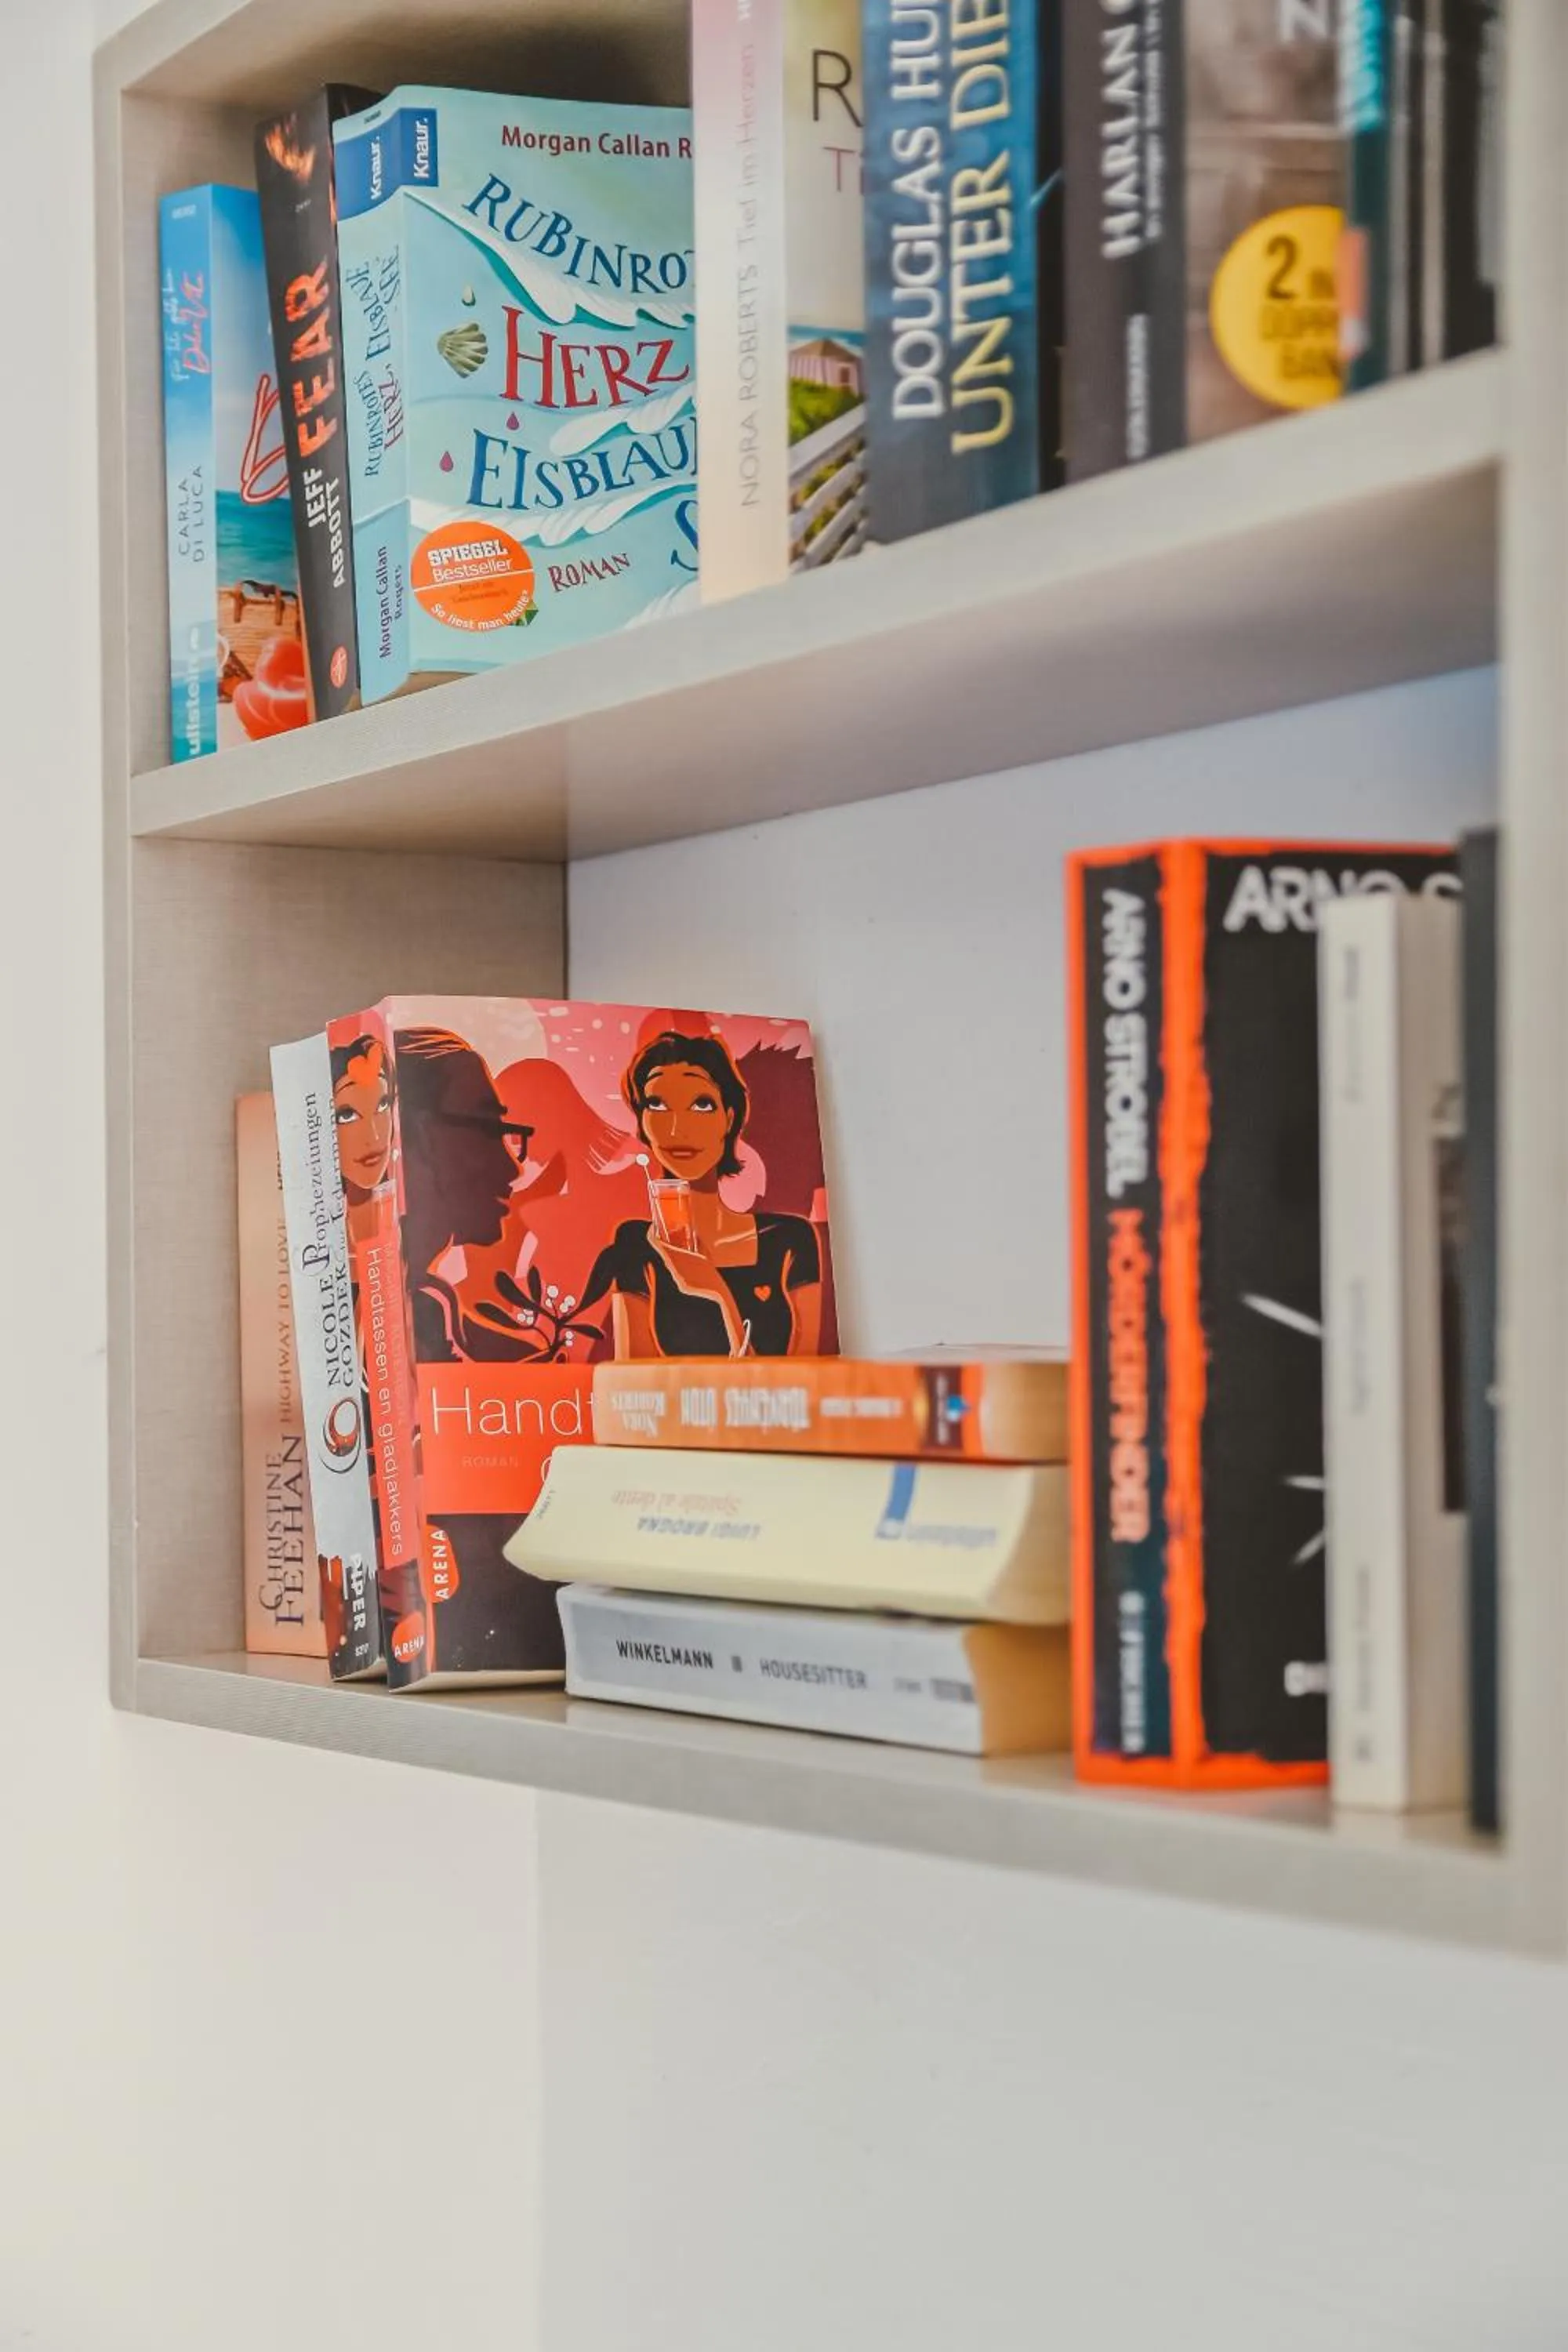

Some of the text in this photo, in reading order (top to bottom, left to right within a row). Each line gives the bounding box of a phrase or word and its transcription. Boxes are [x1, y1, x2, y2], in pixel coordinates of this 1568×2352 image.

[812, 49, 863, 128] R
[502, 125, 692, 158] Morgan Callan R
[1101, 24, 1142, 260] HARLAN
[463, 172, 695, 294] RUBINRO
[890, 0, 945, 419] DOUGLAS HU
[950, 0, 1014, 455] UNTER DIE
[1266, 234, 1299, 300] 2
[285, 256, 338, 458] FEAR
[499, 305, 690, 408] HERZ
[738, 264, 759, 401] ROBERTS
[353, 369, 383, 477] RUBINROTES
[466, 416, 698, 511] EISBLAU
[739, 409, 760, 507] NORA
[179, 478, 191, 556] CARLA
[193, 466, 205, 563] DI LUCA
[303, 467, 325, 528] JEFF
[327, 477, 347, 588] ABBOTT
[427, 539, 509, 566] SPIEGEL
[432, 557, 514, 583] Bestseller
[548, 551, 632, 594] ROMAN
[376, 546, 394, 659] Morgan Callan
[430, 602, 446, 619] So
[447, 613, 475, 630] liest
[477, 617, 504, 630] man
[1102, 887, 1149, 1200] ARNO STROBEL
[302, 1091, 332, 1272] Prophezeiungen
[277, 1282, 290, 1309] TO
[319, 1272, 342, 1388] NICOLE
[334, 1261, 354, 1388] GOZDEK
[365, 1247, 389, 1381] Handtassen
[278, 1323, 292, 1424] HIGHWAY
[379, 1386, 392, 1416] en
[378, 1422, 404, 1555] gladjakkers
[462, 1455, 520, 1468] ROMAN
[257, 1453, 283, 1611] CHRISTINE
[275, 1435, 305, 1627] FEEHAN
[430, 1528, 450, 1602] ARENA
[350, 1553, 367, 1632] PIPER
[394, 1632, 425, 1659] ARENA
[616, 1639, 715, 1670] WINKELMANN
[758, 1657, 869, 1690] HOUSESITTER
